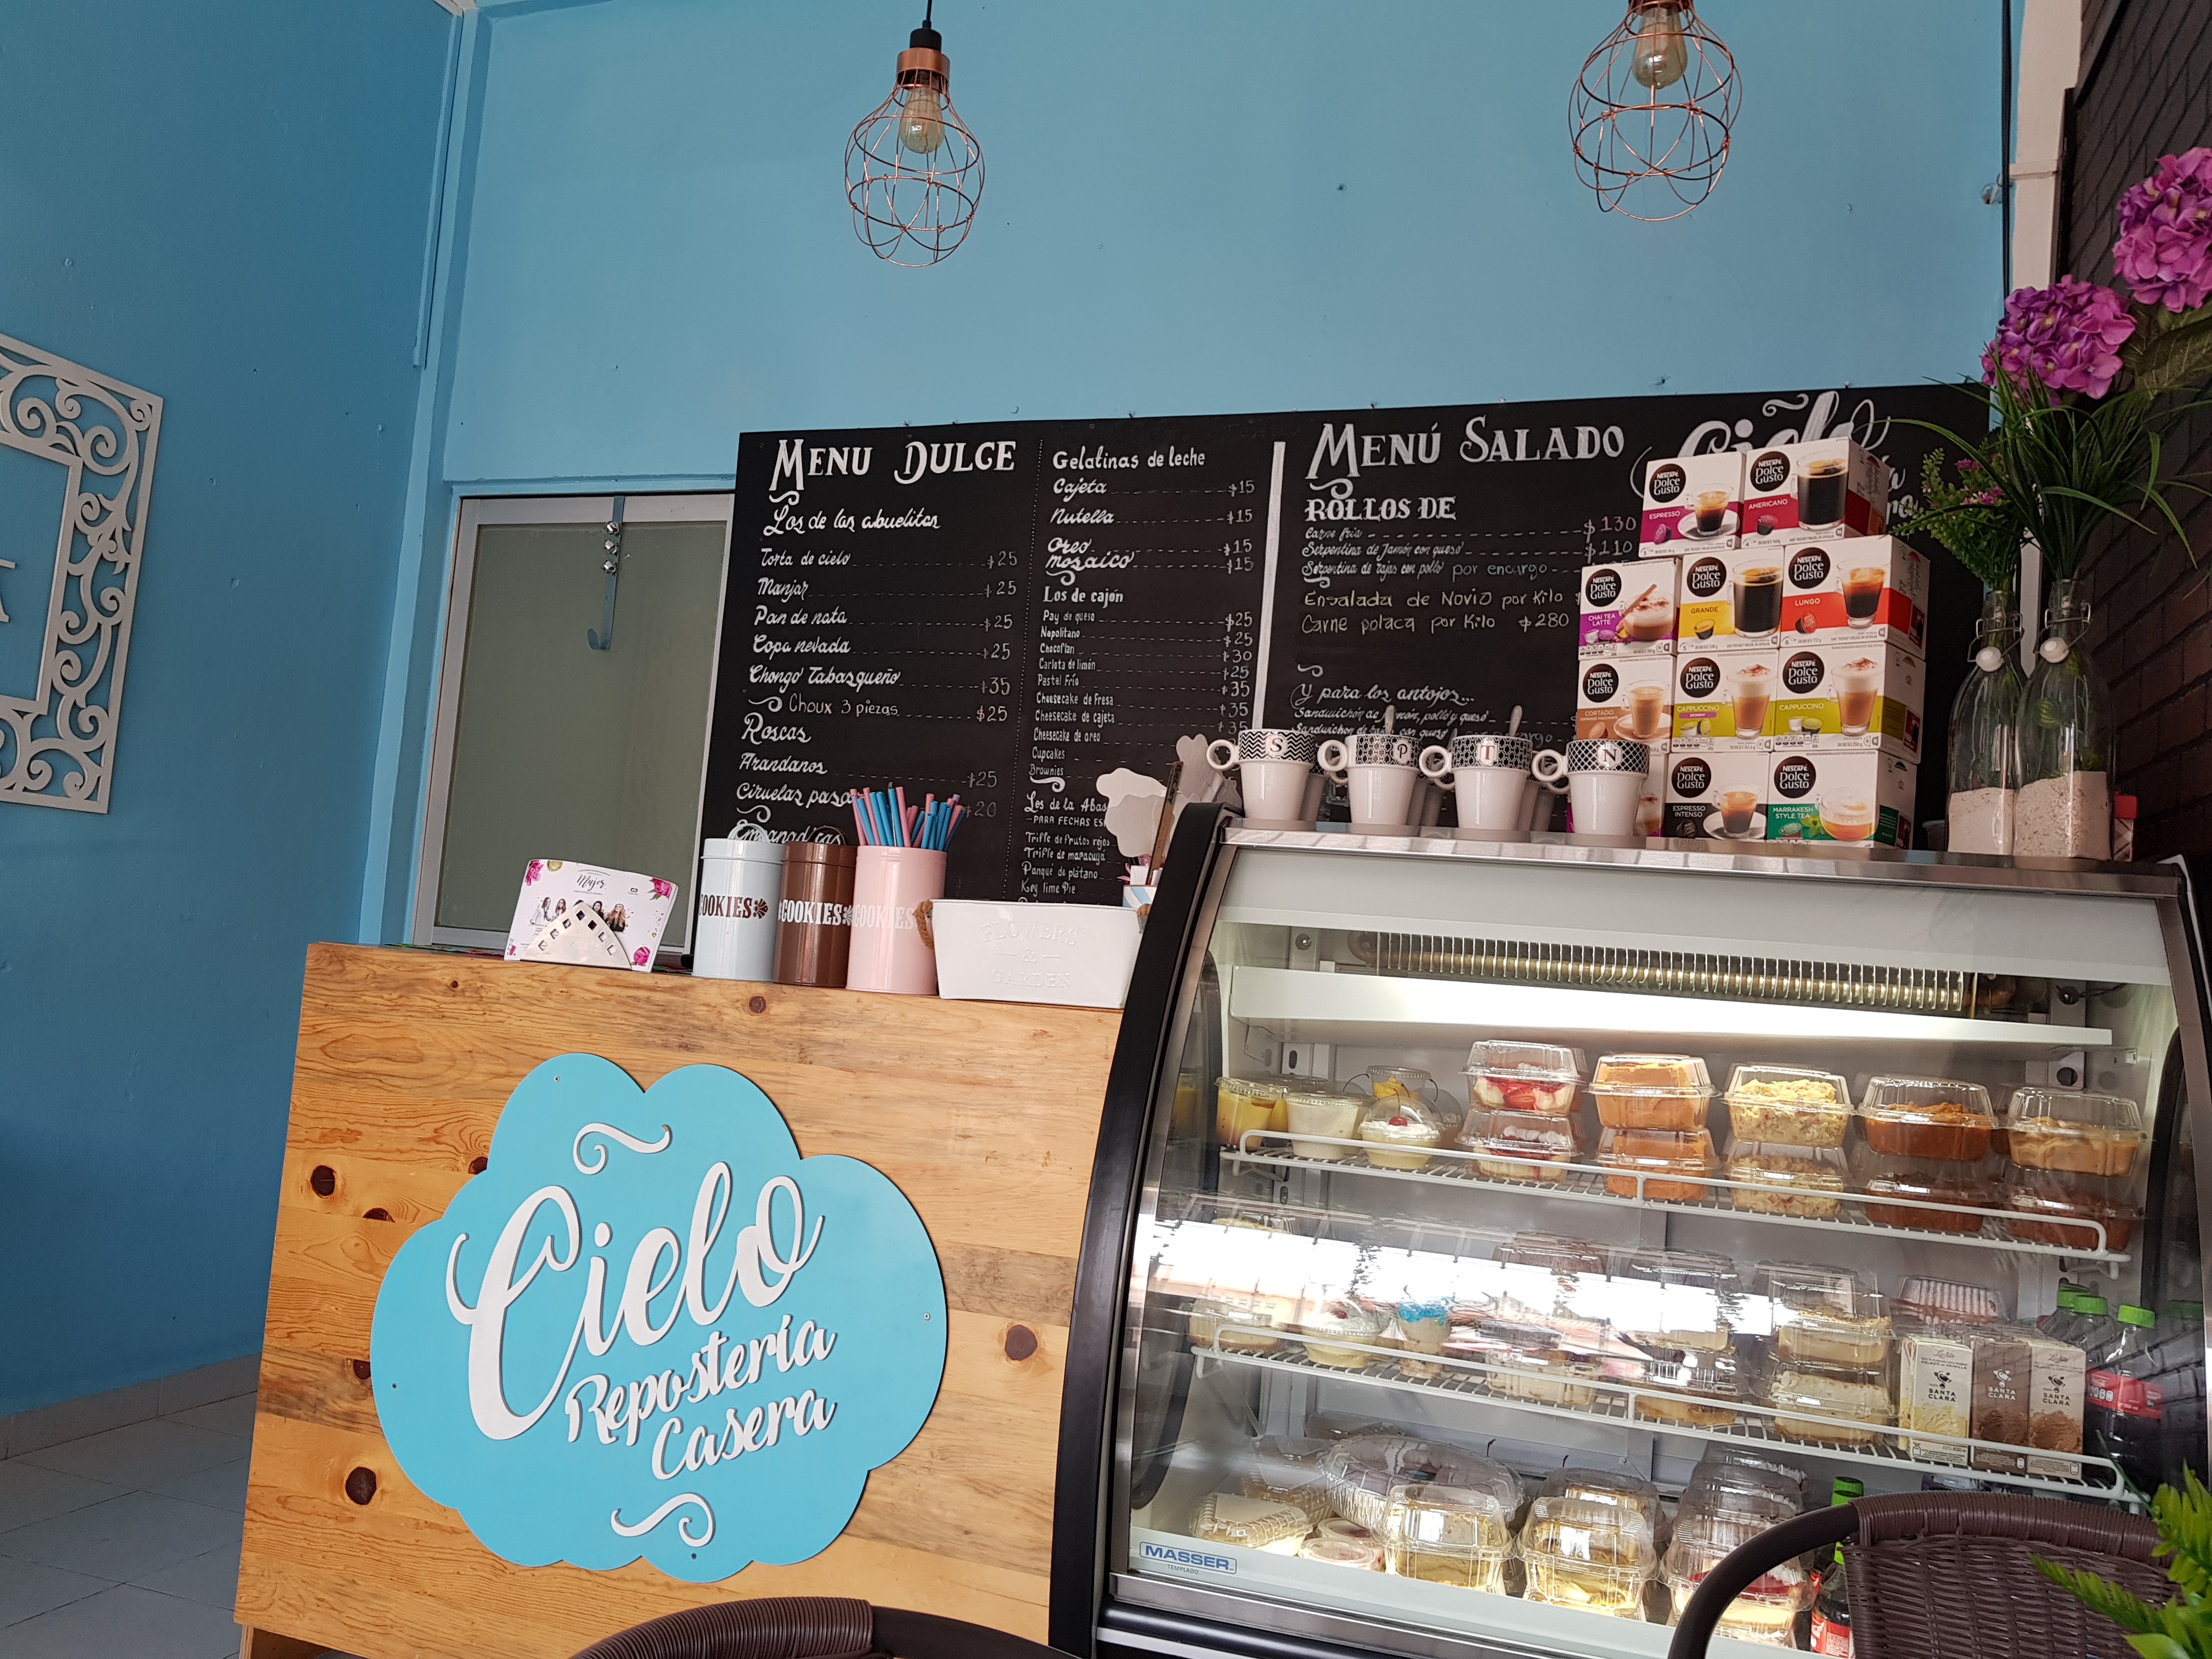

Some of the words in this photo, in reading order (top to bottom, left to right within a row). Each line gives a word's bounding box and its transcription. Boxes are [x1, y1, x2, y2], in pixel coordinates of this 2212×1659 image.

[1305, 422, 1441, 479] MENÚ
[1459, 415, 1624, 462] SALADO
[769, 439, 873, 490] MENU
[894, 441, 1017, 484] DULCE
[1053, 445, 1139, 470] Gelatinas
[1148, 450, 1164, 467] de
[1169, 445, 1205, 467] leche
[1053, 478, 1107, 502] Cajeta
[1654, 478, 1680, 489] Dolce
[1654, 485, 1680, 496] Gusto
[1305, 498, 1411, 522] ROLLOS
[1418, 497, 1456, 520] DE
[1748, 499, 1788, 510] AMERICANO
[763, 505, 805, 536] Los
[808, 511, 827, 529] de
[834, 509, 855, 532] las
[862, 507, 940, 529] abuelitas
[1051, 507, 1114, 524] Nutella
[1649, 511, 1680, 520] ESPRESSO
[1305, 527, 1335, 540] Carne
[1047, 537, 1092, 554] Oreo
[1302, 541, 1361, 557] Serpentina
[1366, 544, 1378, 555] de
[1414, 545, 1429, 554] con
[1432, 541, 1464, 558] queso
[761, 548, 793, 567] Torta
[801, 550, 815, 565] de
[818, 550, 851, 566] cielo
[1302, 561, 1357, 575] Serpentina
[1361, 562, 1372, 574] de
[1401, 564, 1415, 574] con
[1417, 560, 1444, 579] pollo
[1453, 564, 1477, 583] por
[1487, 563, 1547, 580] encargo
[1692, 572, 1720, 581] Dolce
[758, 578, 808, 602] Manjar
[1692, 579, 1720, 589] Gusto
[1042, 586, 1067, 603] Los
[1071, 587, 1086, 602] de
[1091, 589, 1124, 608] cajón
[1305, 590, 1392, 607] Ensalada
[1407, 590, 1430, 606] de
[1442, 589, 1491, 605] Novio
[1502, 595, 1525, 610] por
[1795, 598, 1820, 606] LUNGO
[754, 605, 787, 625] Pan
[791, 607, 808, 625] de
[811, 606, 848, 624] nata
[1043, 610, 1059, 624] Pay
[1063, 611, 1073, 621] de
[1075, 613, 1095, 628] queso
[1041, 627, 1080, 640] Napolitano
[1302, 616, 1347, 634] Carne
[1361, 616, 1415, 635] polaca
[1431, 616, 1455, 635] por
[753, 634, 791, 660] Copa
[795, 637, 851, 653] nevada
[1040, 642, 1075, 654] Chocoflan
[1039, 659, 1065, 670] Carlota
[1068, 659, 1076, 670] de
[1077, 659, 1096, 671] limón
[1788, 667, 1818, 676] Dolce
[749, 665, 804, 693] Chongo
[808, 665, 900, 692] Tabasqueño
[1037, 674, 1062, 686] Pastel
[1788, 675, 1818, 685] Gusto
[1036, 692, 1078, 706] Cheesecake
[1083, 694, 1092, 706] de
[1094, 693, 1113, 706] Fresa
[1317, 685, 1362, 704] para
[1364, 685, 1392, 702] los
[789, 693, 832, 714] Choux
[841, 699, 851, 713] 3
[856, 699, 898, 716] piezas
[977, 706, 1008, 723] $25
[1035, 709, 1077, 723] Cheesecake
[1081, 711, 1090, 723] de
[1093, 710, 1115, 728] cajeta
[741, 713, 811, 745] Roscas
[1034, 727, 1070, 742] Cheesecake
[1074, 729, 1082, 741] de
[1085, 731, 1101, 742] oreo
[1269, 736, 1283, 752] S
[1397, 743, 1408, 758] P
[1481, 745, 1494, 759] T
[1032, 746, 1065, 761] Cupcakes
[1602, 749, 1617, 761] N
[739, 753, 828, 774] Arandanos
[1029, 764, 1063, 776] Brownies
[1780, 771, 1810, 782] Dolce
[1780, 780, 1809, 790] Gusto
[736, 782, 803, 806] Ciruelas
[1024, 791, 1044, 812] Los
[1050, 798, 1059, 810] de
[1063, 797, 1074, 810] la
[1034, 815, 1054, 824] PARA
[1058, 816, 1090, 826] FECHAS
[1054, 836, 1063, 844] de
[1093, 837, 1110, 850] rojos
[1057, 850, 1064, 859] de
[1022, 861, 1053, 879] Panqué
[1058, 867, 1065, 877] de
[1069, 867, 1098, 879] plátano
[1021, 879, 1038, 896] Key
[1043, 881, 1060, 893] lime
[1062, 880, 1075, 894] Pie
[699, 894, 752, 918] COOKIES
[781, 900, 842, 926] COOKIES
[854, 904, 915, 929] COOKIES
[982, 921, 1079, 946] FLOWERS
[1022, 947, 1036, 963] &
[991, 969, 1070, 988] GARDEN
[445, 1161, 825, 1440] Cielo
[566, 1313, 838, 1447] Repostería
[1928, 1388, 1956, 1396] SANTA
[1928, 1394, 1956, 1402] CLARA
[1988, 1386, 2016, 1395] SANTA
[1988, 1392, 2016, 1401] CLARA
[651, 1389, 838, 1480] Casera
[1146, 1545, 1229, 1570] MASSER
[1167, 1564, 1199, 1575] TEMPLADO
